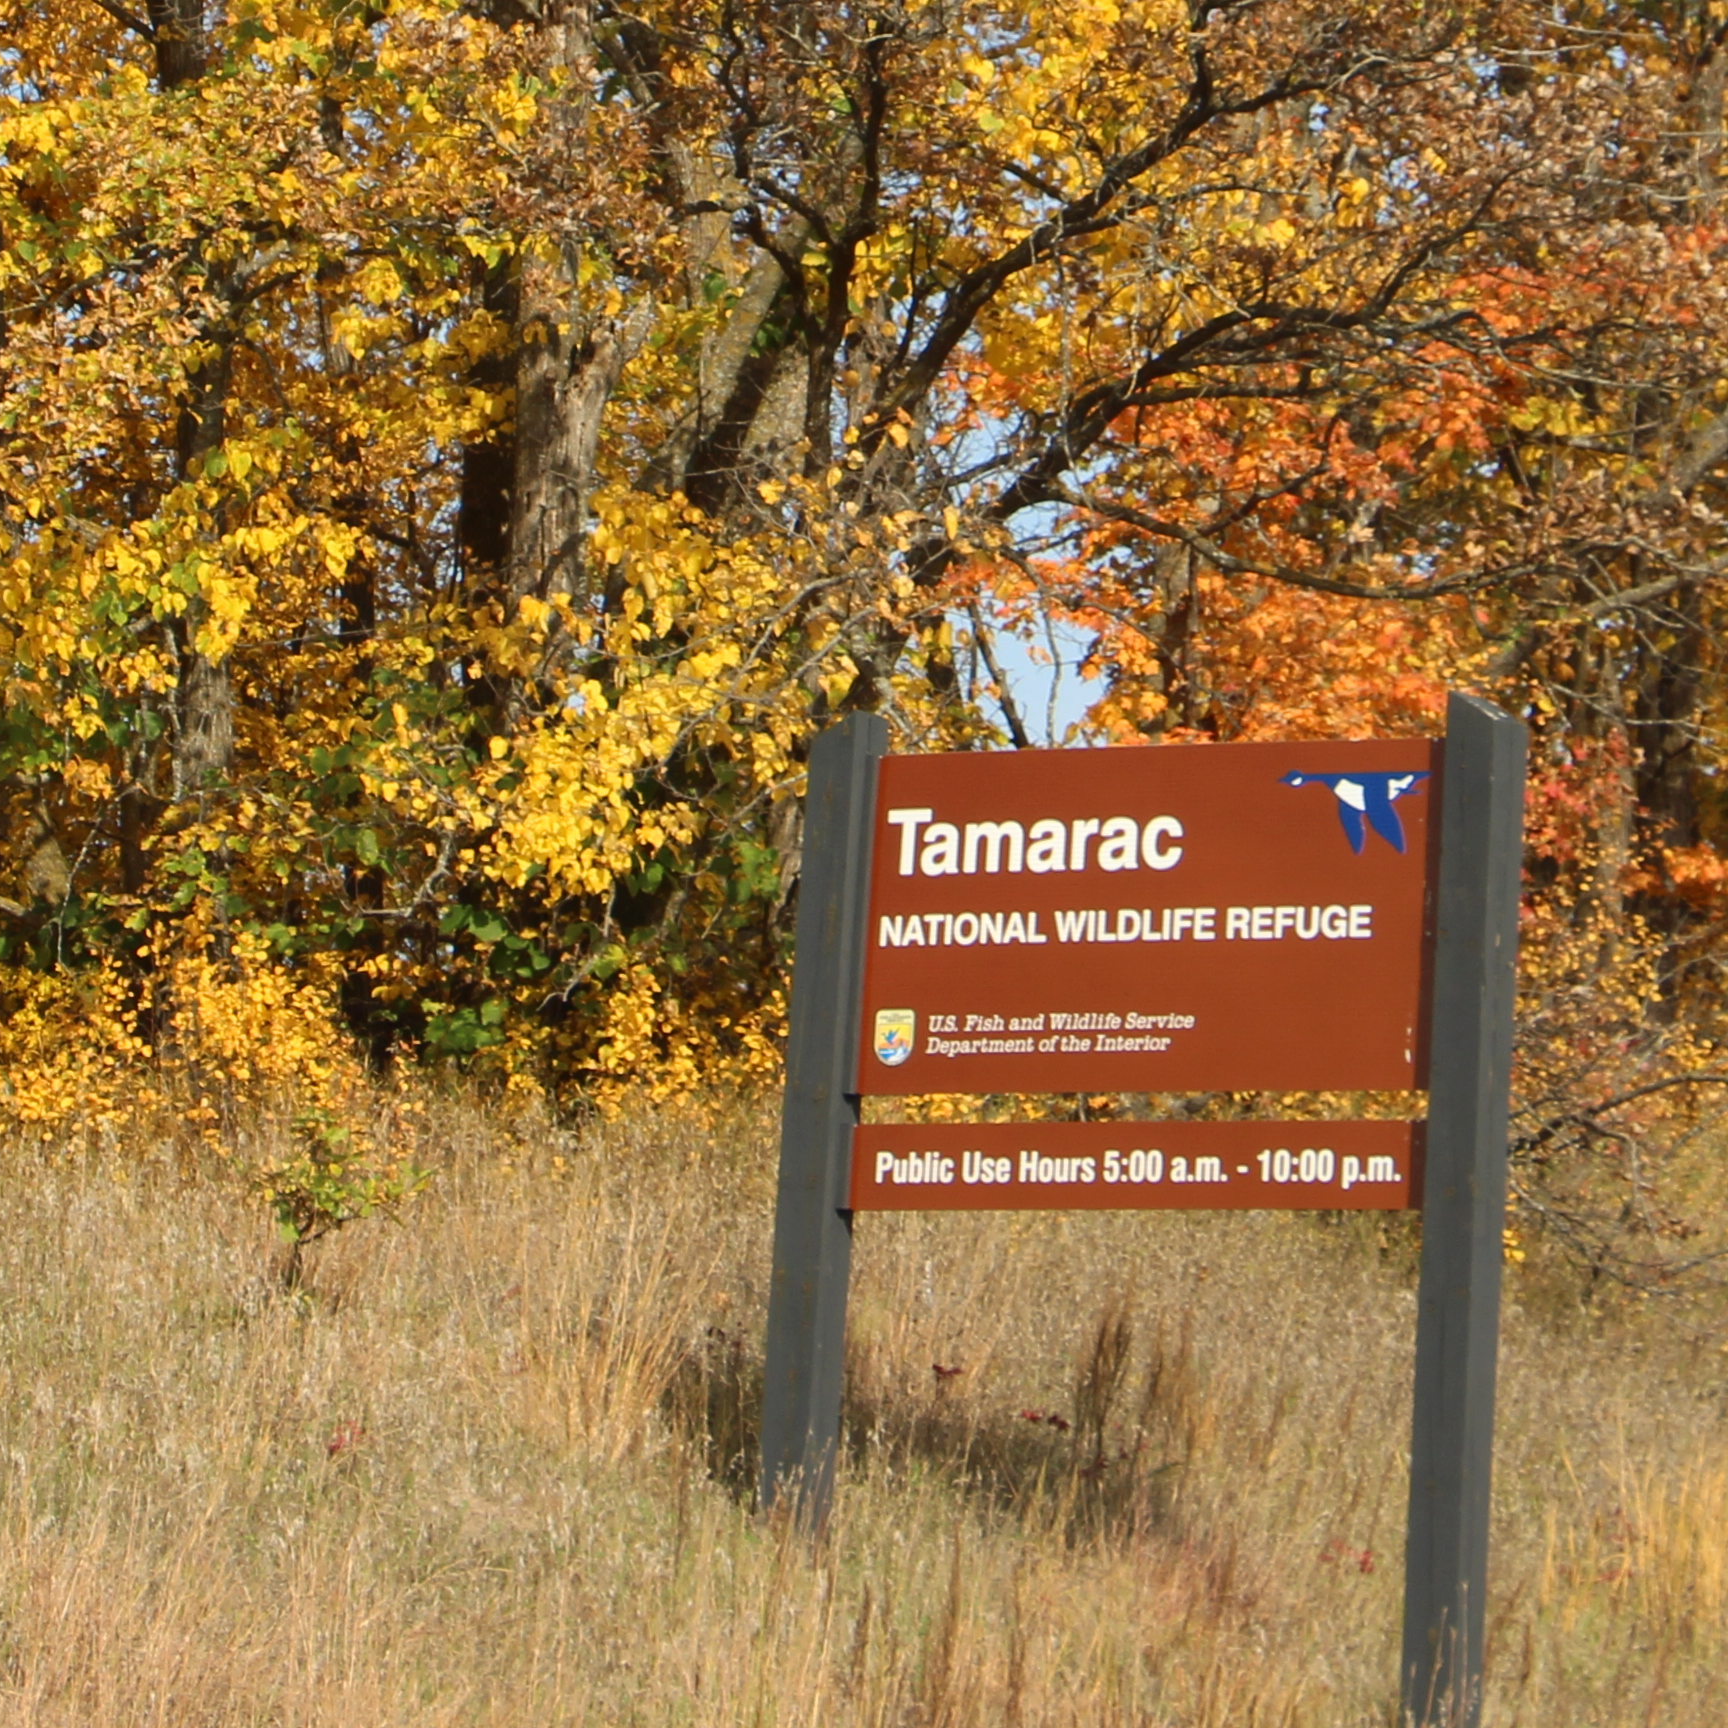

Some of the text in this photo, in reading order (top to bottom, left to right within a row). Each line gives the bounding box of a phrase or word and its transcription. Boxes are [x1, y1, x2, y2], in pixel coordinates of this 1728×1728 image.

[887, 808, 1184, 877] Tamarac
[879, 904, 1373, 948] NATIONAL WILDLIFE REFUGE
[928, 1014, 958, 1031] U.S.
[963, 1014, 1004, 1031] Fish
[1008, 1013, 1045, 1030] and
[1049, 1012, 1122, 1029] Wildlife
[1124, 1011, 1195, 1028] Service
[925, 1034, 1171, 1056] Department of the Interior
[875, 1151, 955, 1185] Public
[962, 1151, 1012, 1185] Use
[1018, 1150, 1096, 1184] Hours
[1103, 1149, 1164, 1184] 5:00
[1170, 1156, 1229, 1183] a.m.
[1257, 1149, 1335, 1184] 10:00
[1341, 1156, 1402, 1190] p.m.
